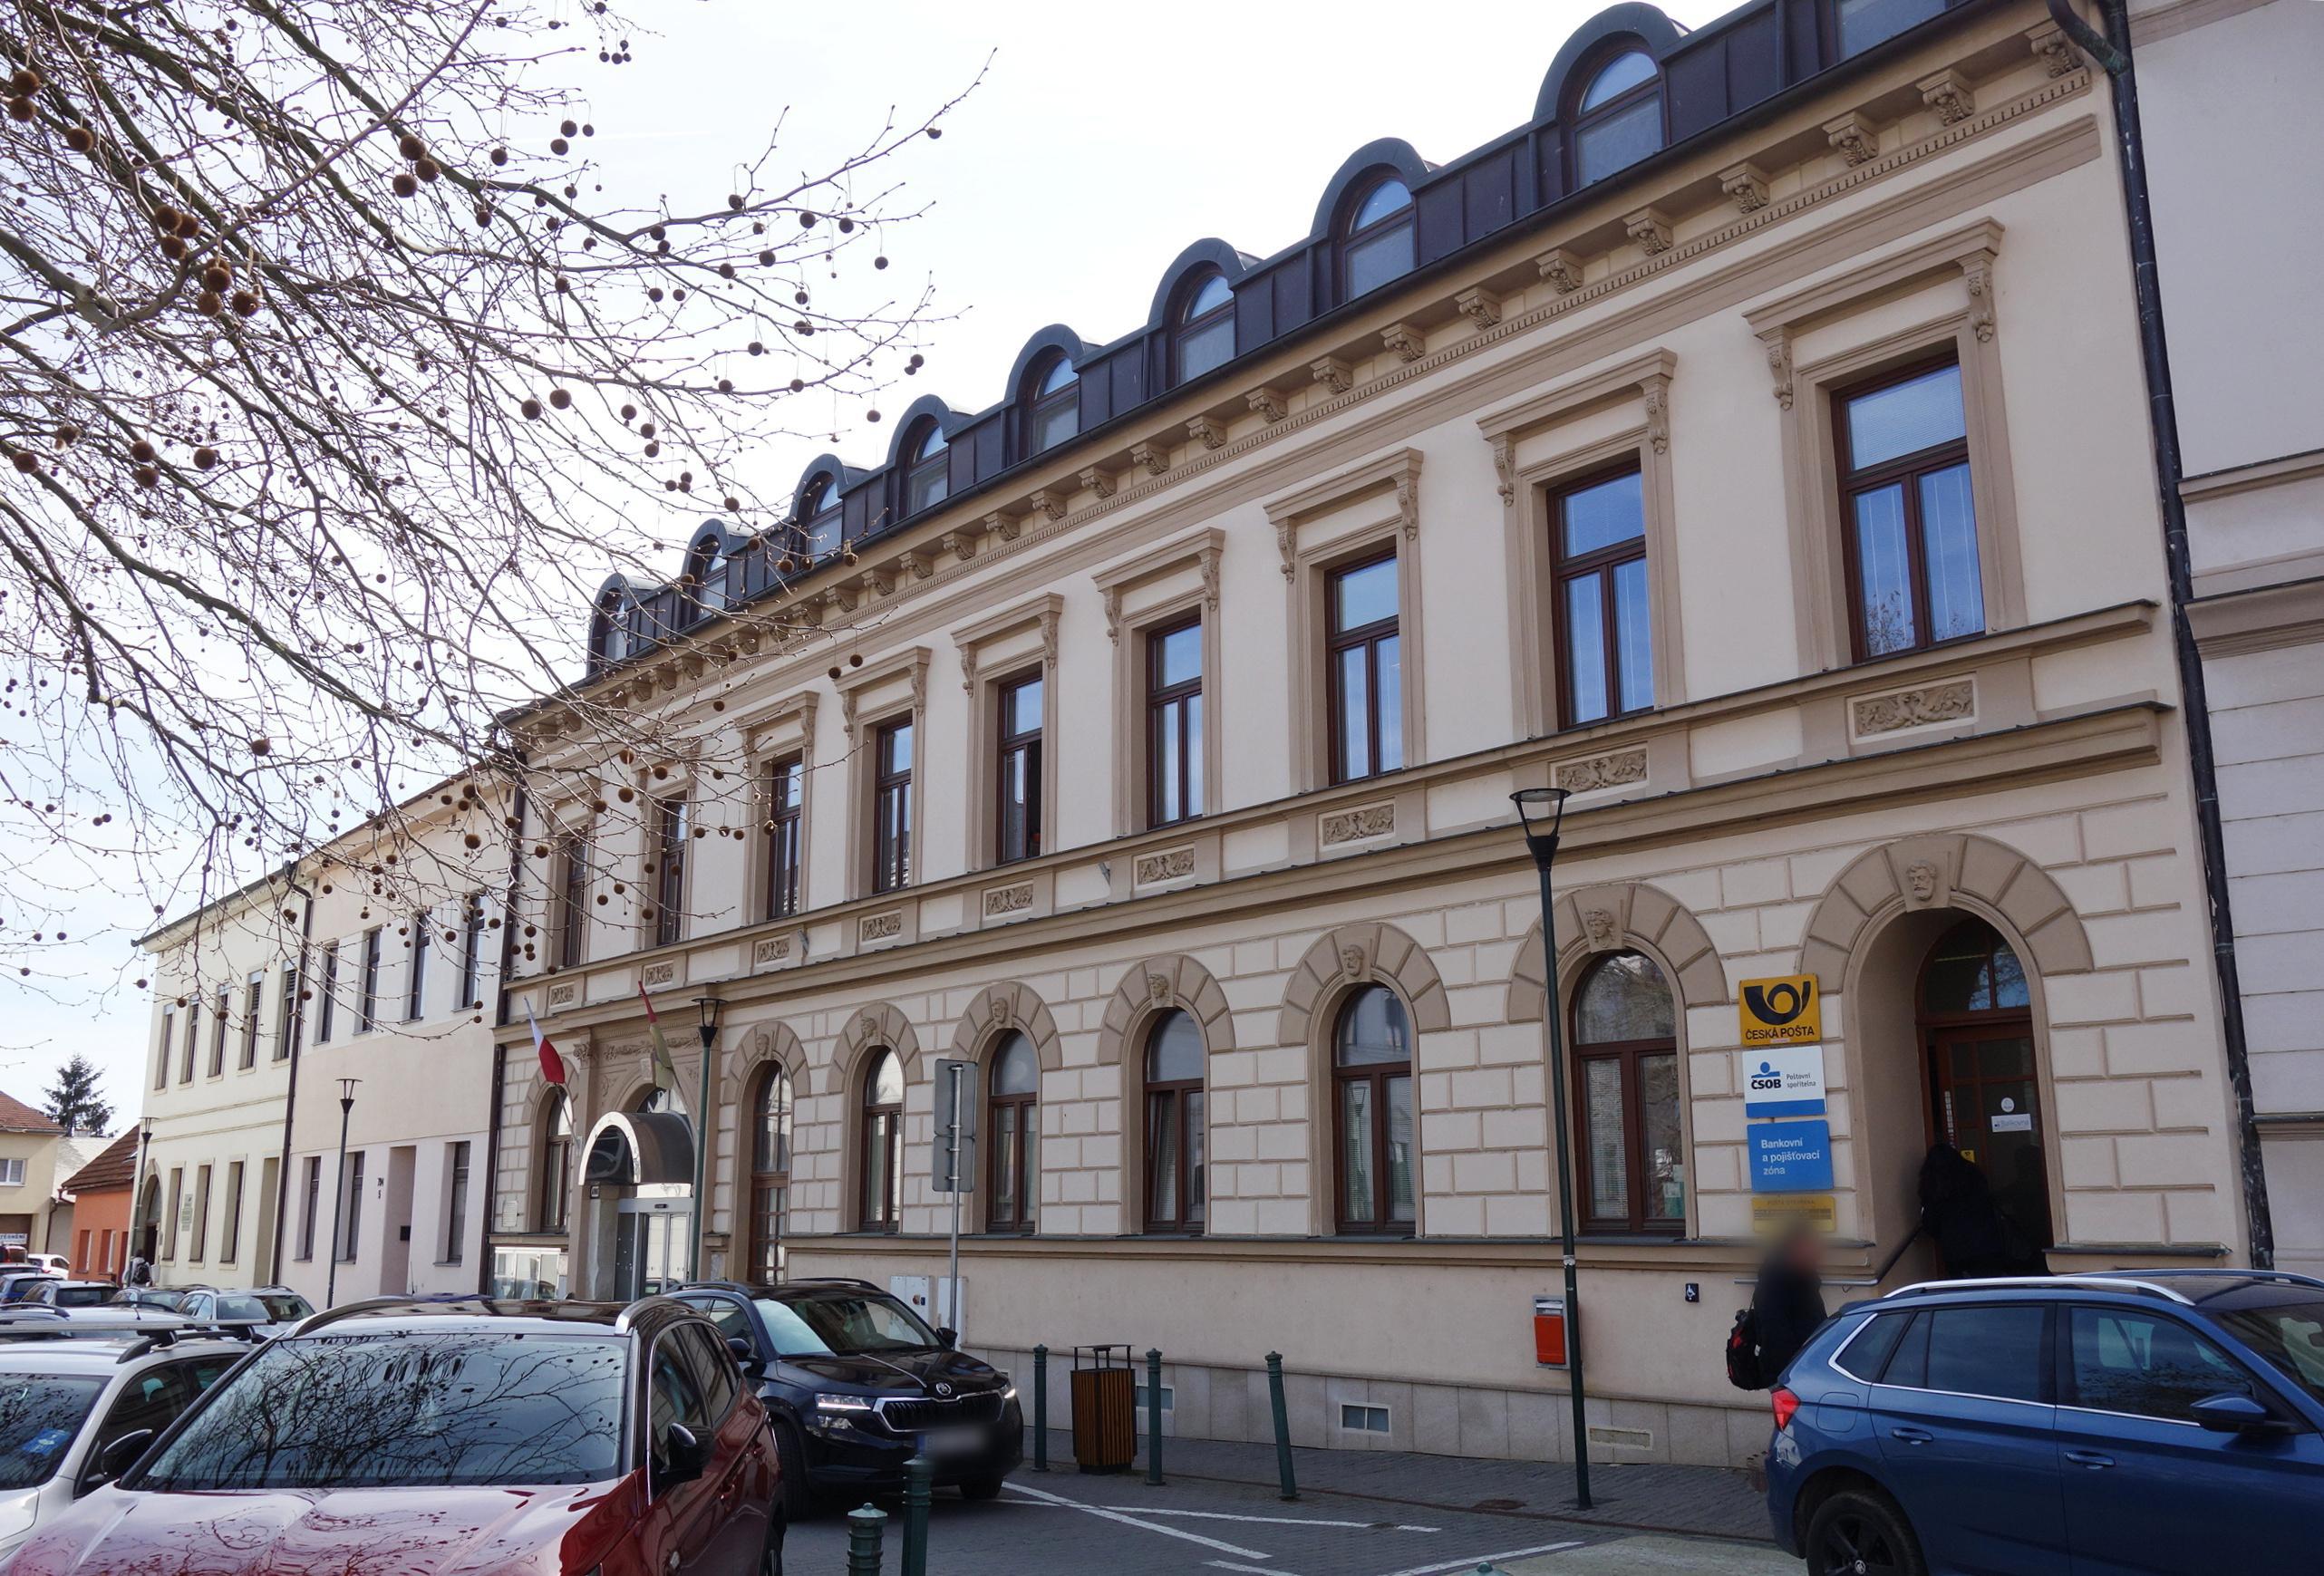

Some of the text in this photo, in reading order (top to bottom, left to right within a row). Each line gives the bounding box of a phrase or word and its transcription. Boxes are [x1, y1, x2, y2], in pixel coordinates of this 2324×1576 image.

[1745, 1025, 1815, 1039] ČESKÁ POŠTA
[1787, 1072, 1811, 1080] Poštovní
[1751, 1078, 1781, 1089] ČSOB
[1787, 1080, 1816, 1088] spořitelna
[1761, 1136, 1803, 1149] Bankovní
[1770, 1150, 1820, 1163] pojišťovací
[1763, 1165, 1786, 1175] zóna
